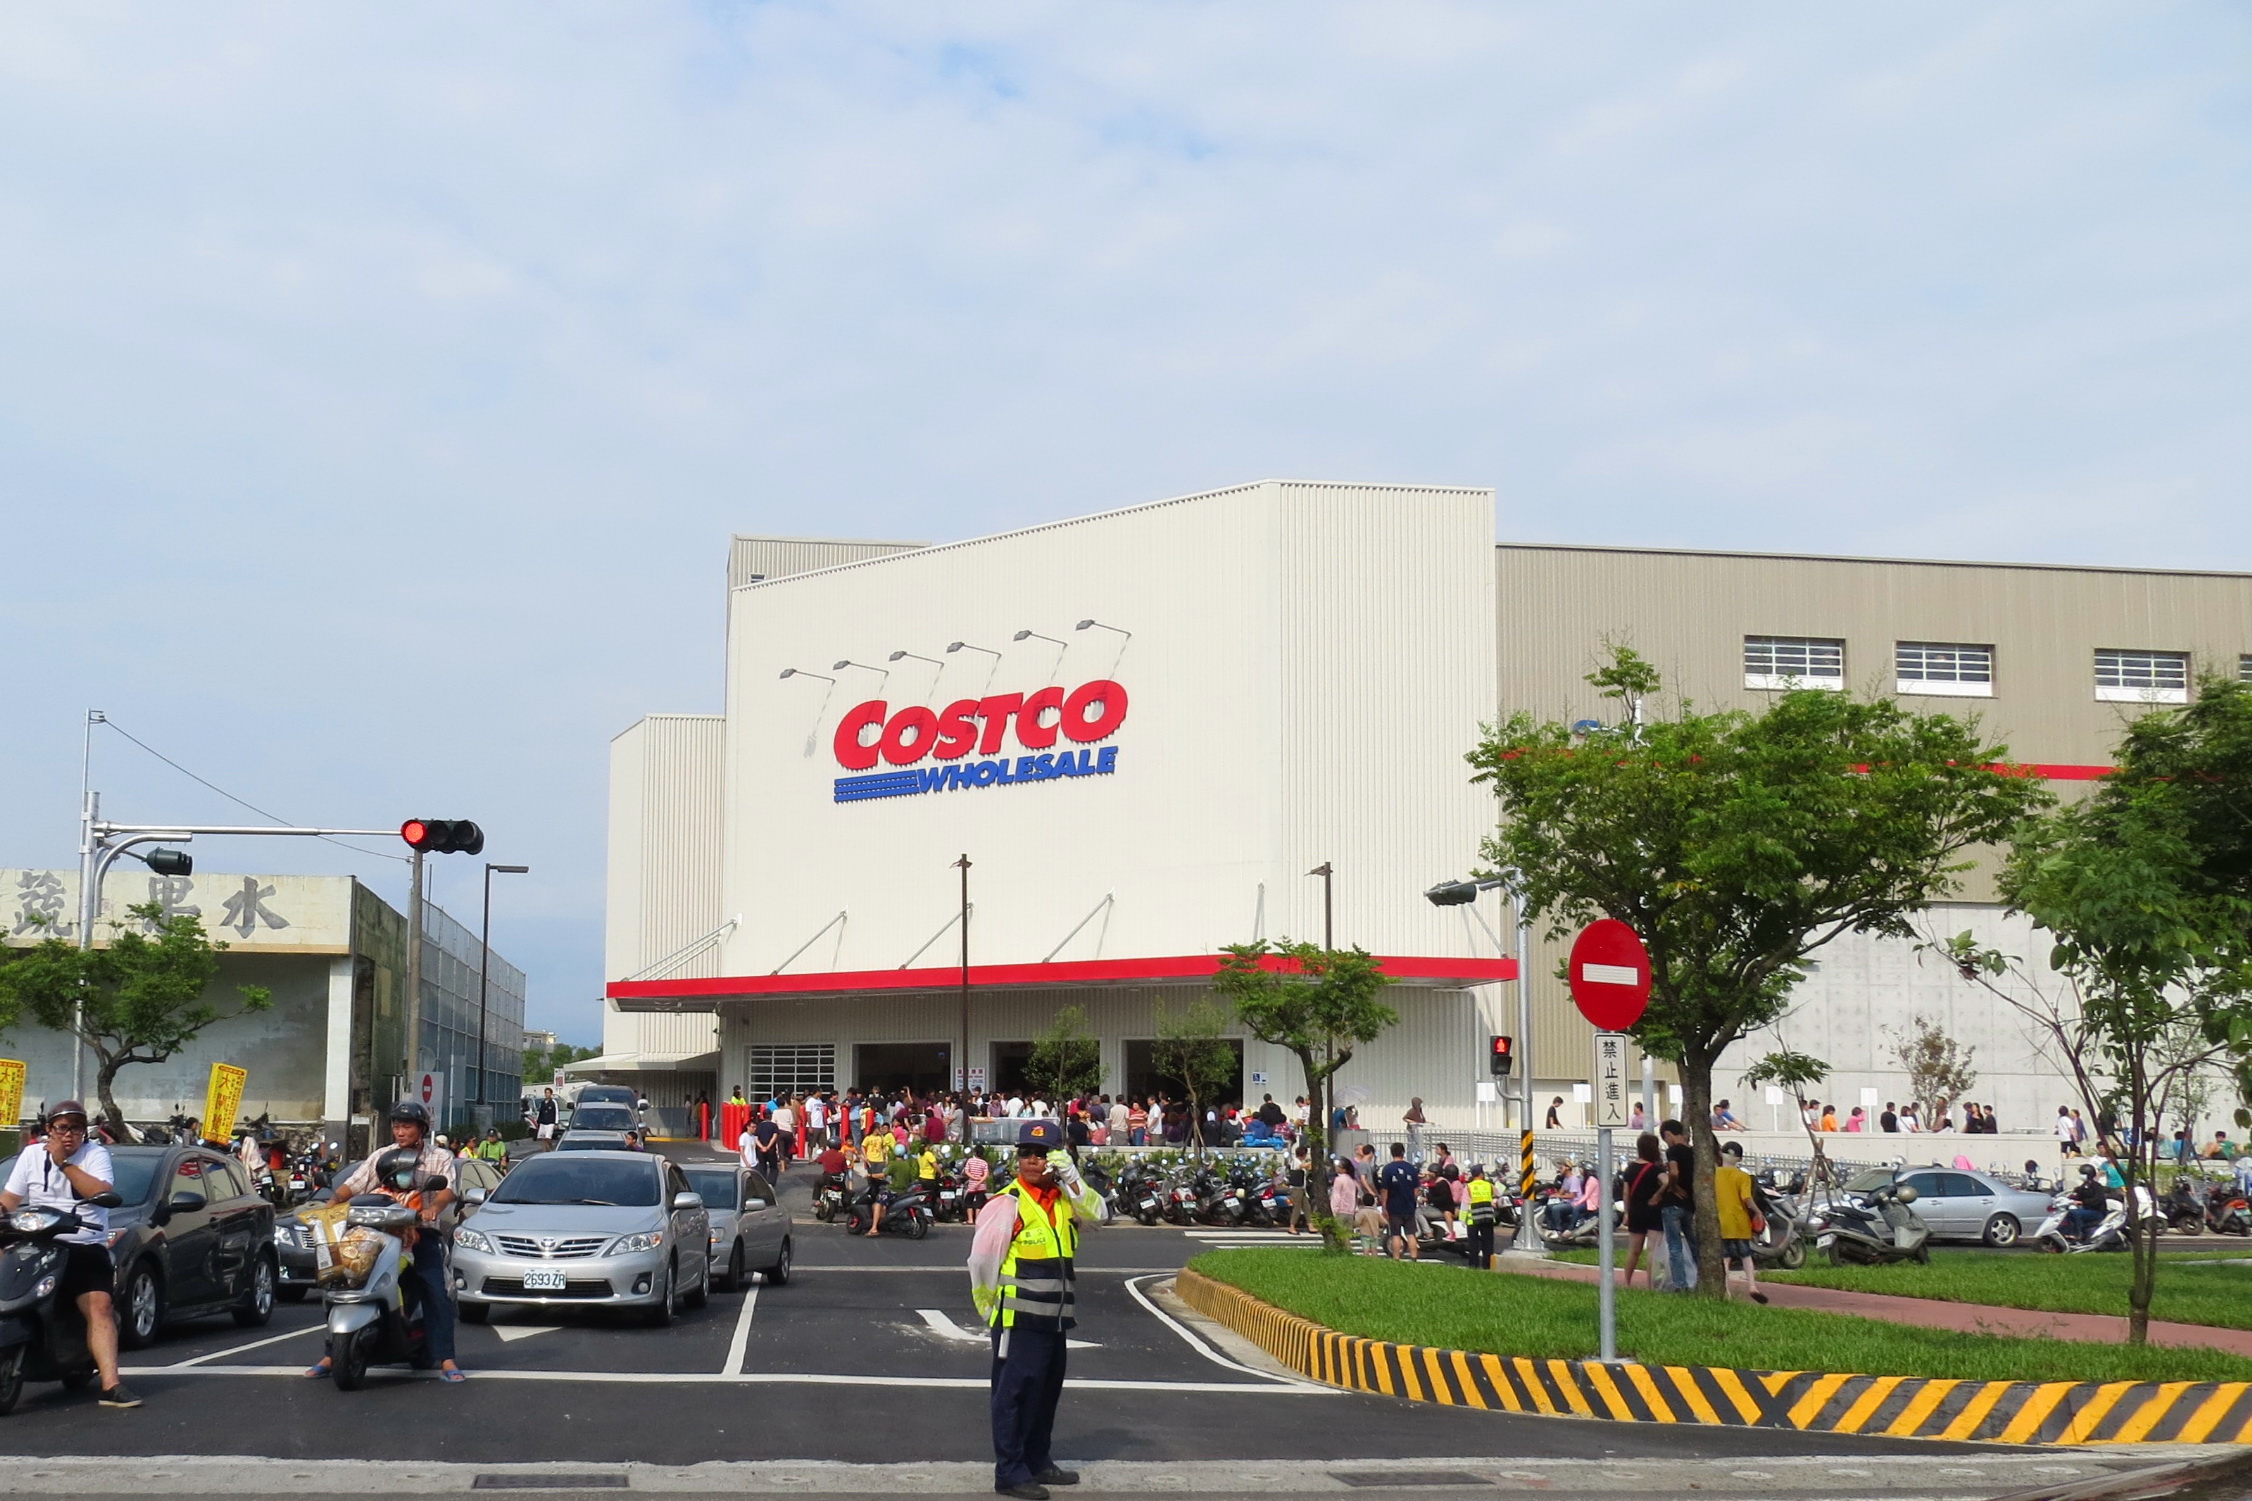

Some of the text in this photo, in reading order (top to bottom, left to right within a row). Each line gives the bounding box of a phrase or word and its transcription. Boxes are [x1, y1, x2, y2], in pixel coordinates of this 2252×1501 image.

[834, 680, 1128, 769] COSTCO
[917, 746, 1118, 792] WHOLESALE
[1603, 1040, 1620, 1120] 禁止進入
